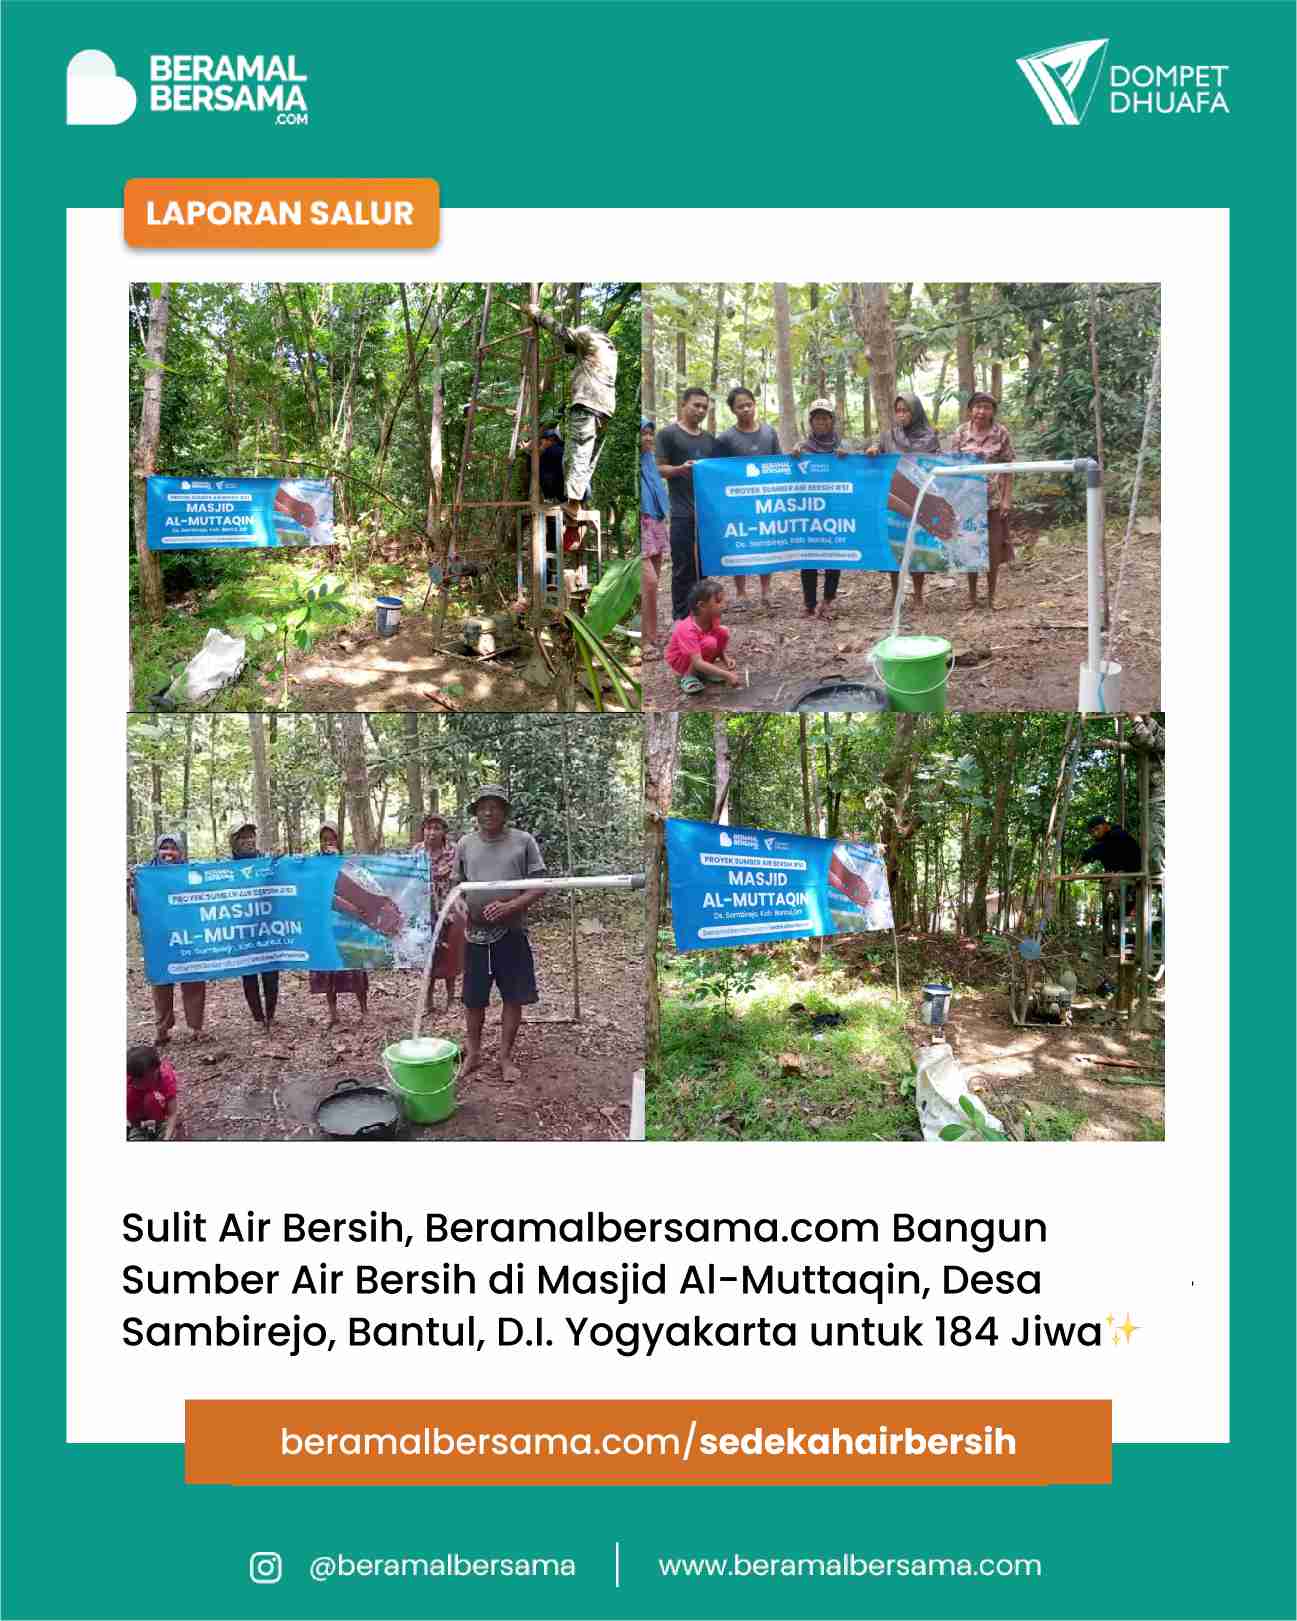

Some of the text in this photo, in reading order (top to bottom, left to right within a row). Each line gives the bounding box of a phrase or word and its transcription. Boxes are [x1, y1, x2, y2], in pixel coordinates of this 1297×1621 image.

[186, 503, 235, 513] MASJID
[755, 497, 826, 514] MASJID
[165, 516, 256, 527] AL-MUTTAQIN
[724, 518, 857, 538] AL-MUTTAQIN
[728, 870, 789, 886] MASJID
[703, 892, 810, 909] AL-MUTTAQIN
[200, 901, 273, 923] MASJID
[169, 920, 303, 948] AL-MUTTAQIN
